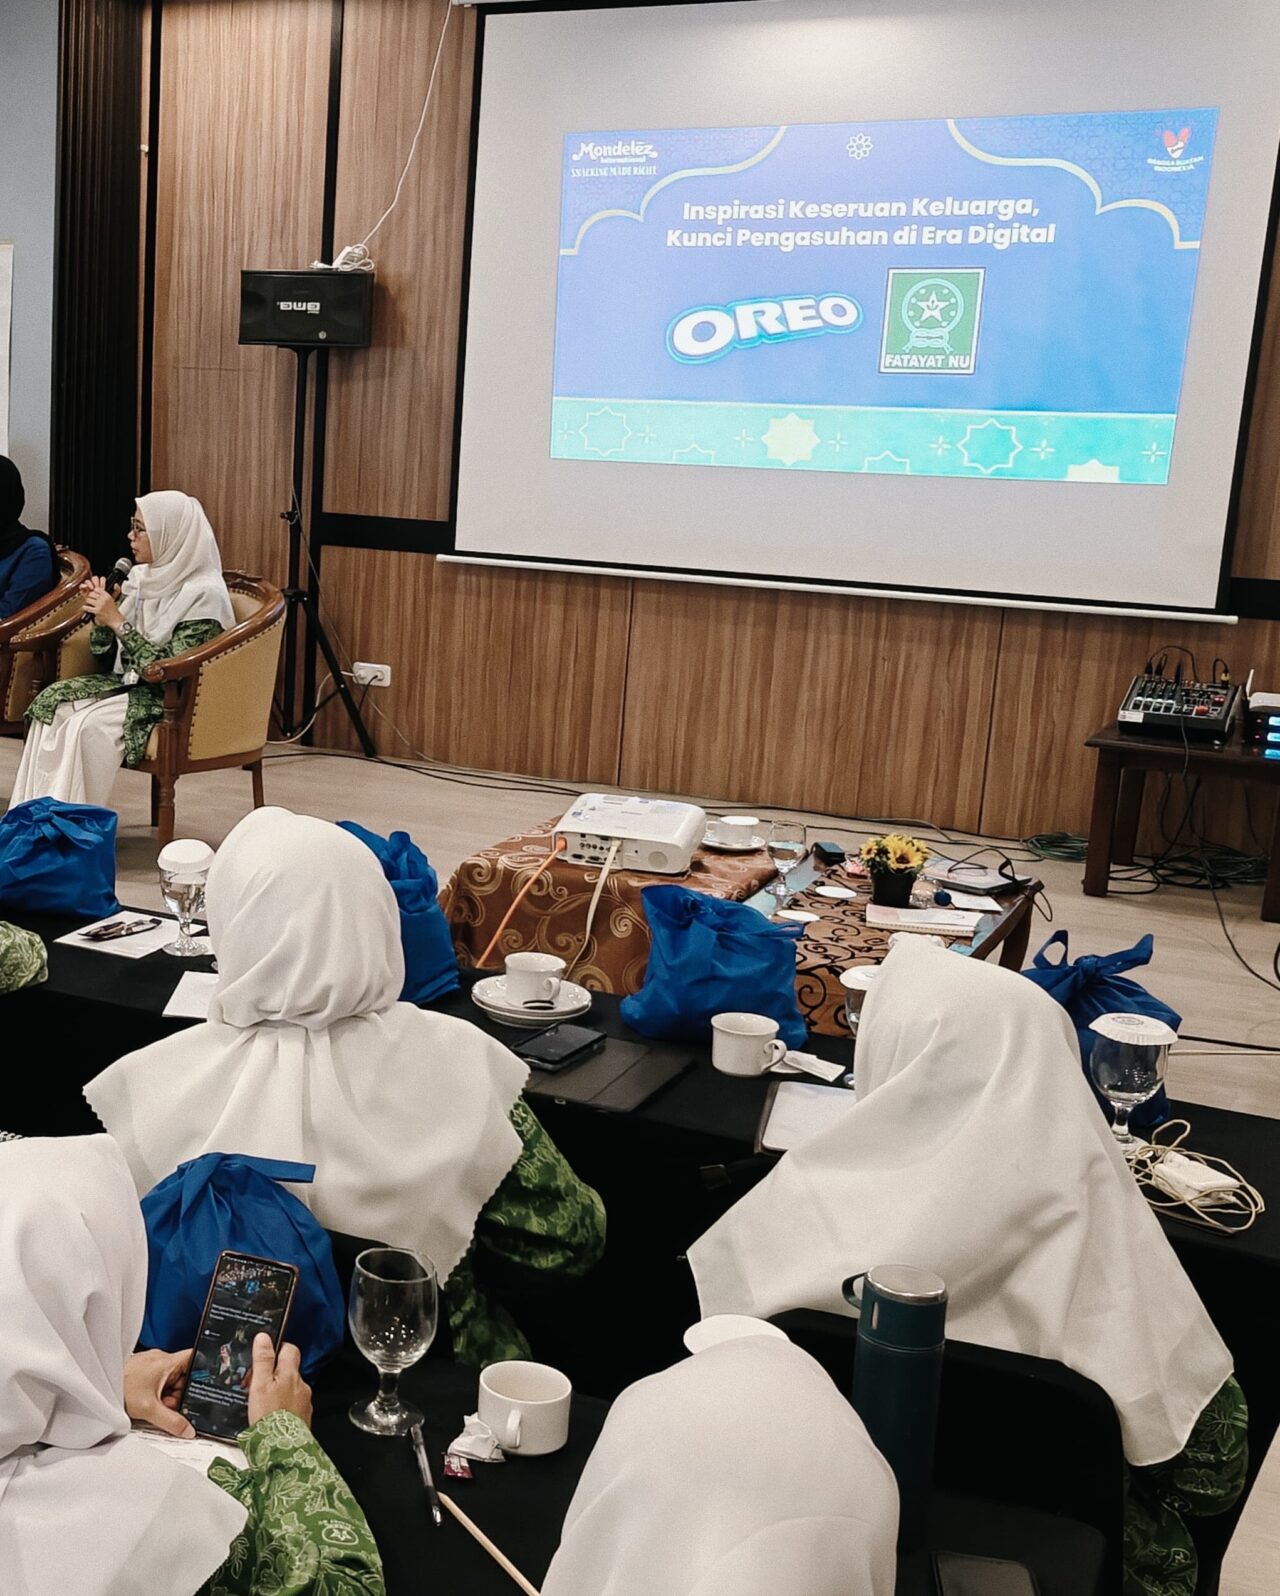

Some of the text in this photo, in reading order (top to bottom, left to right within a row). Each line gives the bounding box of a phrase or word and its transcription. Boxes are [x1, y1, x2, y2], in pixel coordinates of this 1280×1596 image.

[683, 196, 1040, 225] Inspirasi Keseruan Keluarga,
[667, 223, 1056, 252] Kunci Pengasuhan di Era Digital
[672, 295, 858, 356] OREO
[884, 354, 971, 368] FATAYAT NU
